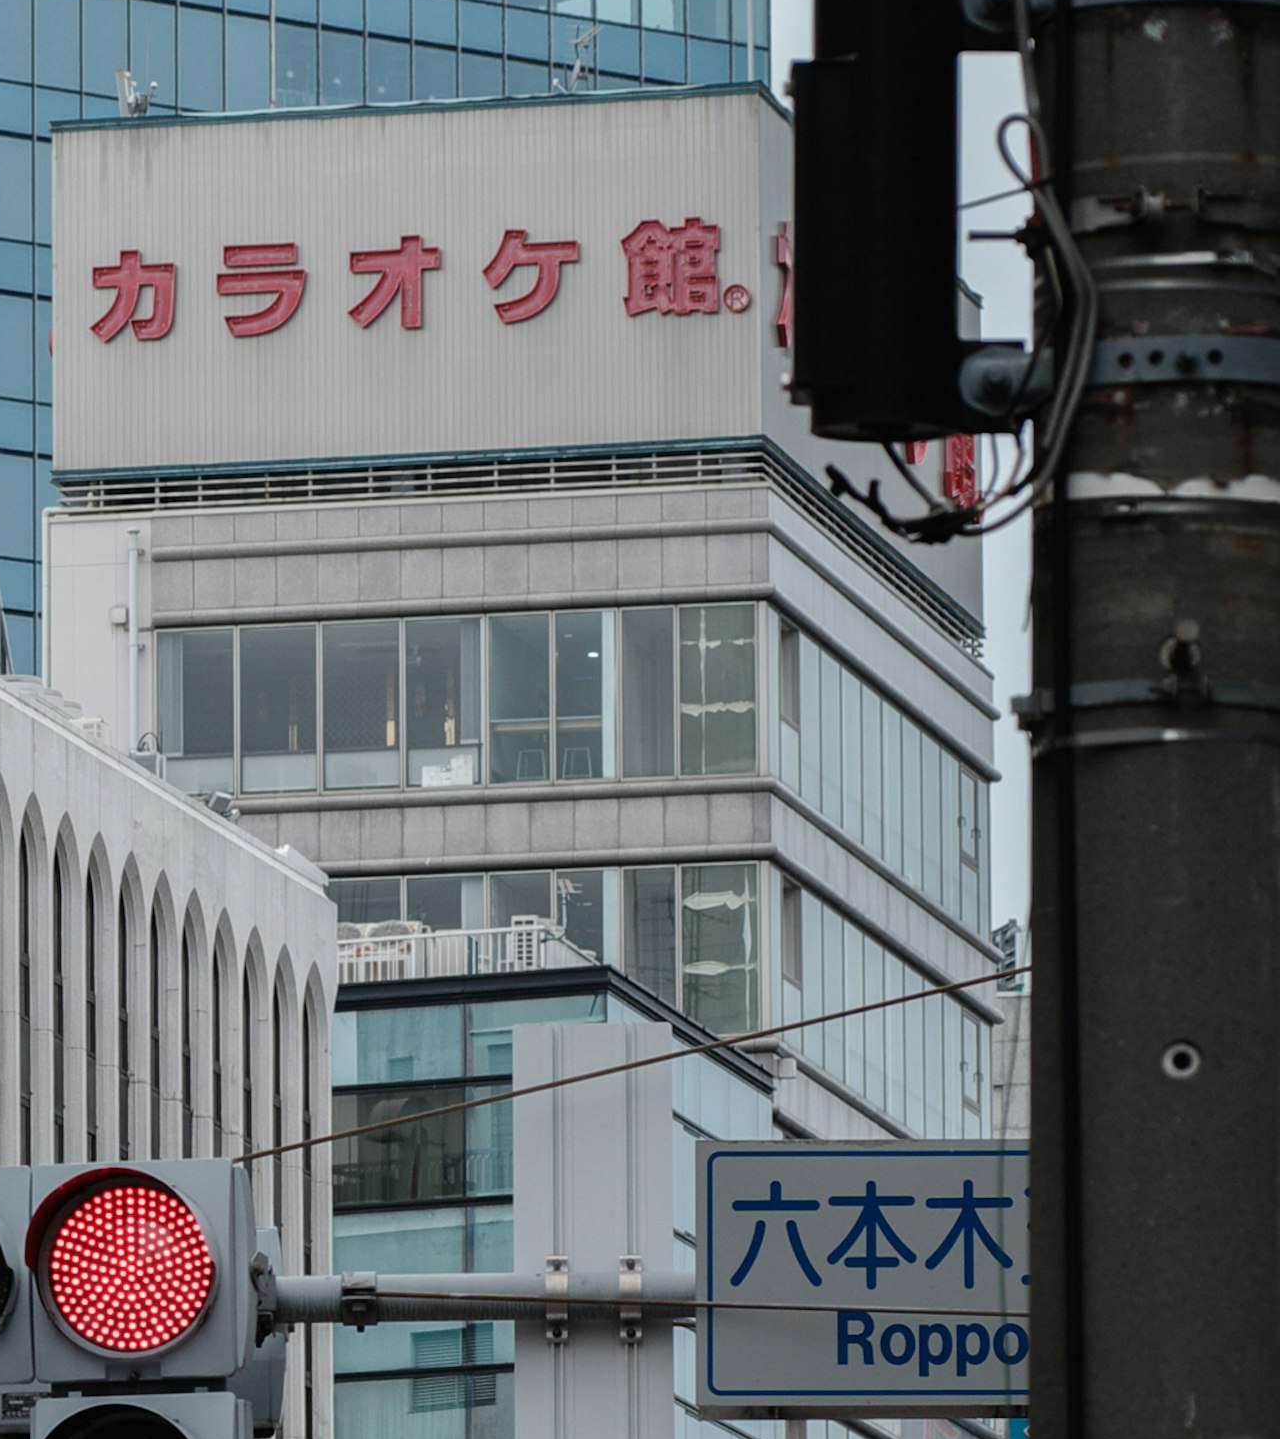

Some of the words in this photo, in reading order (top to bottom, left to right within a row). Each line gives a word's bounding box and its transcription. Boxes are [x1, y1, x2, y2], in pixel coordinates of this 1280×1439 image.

[89, 217, 720, 344] カラオケ館
[730, 1179, 1030, 1290] 六本木
